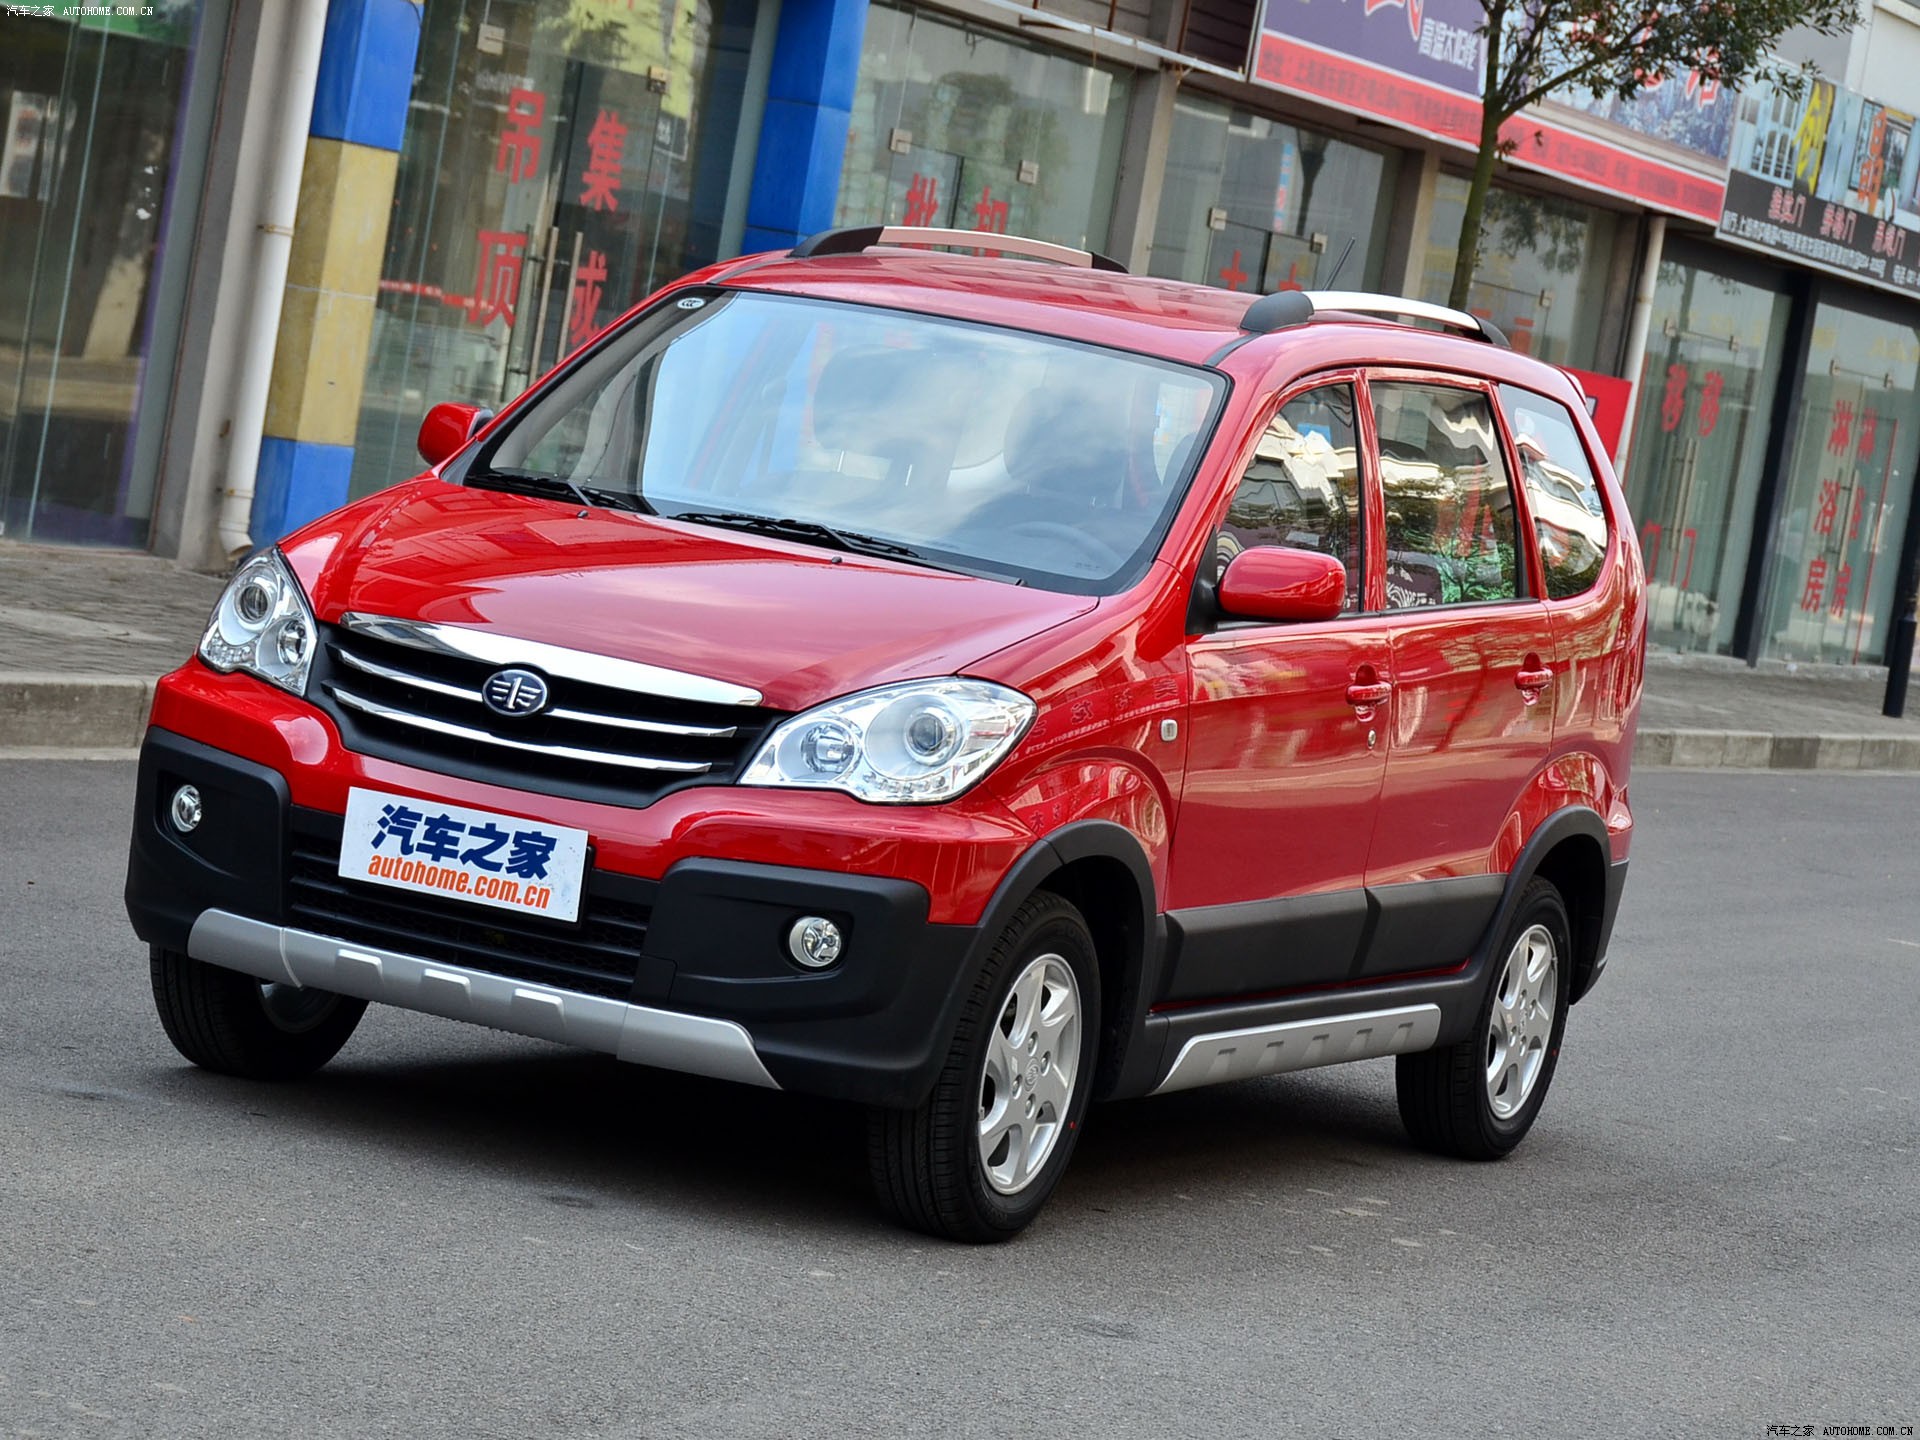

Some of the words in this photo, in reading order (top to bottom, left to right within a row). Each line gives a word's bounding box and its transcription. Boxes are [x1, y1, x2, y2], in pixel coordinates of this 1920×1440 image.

[467, 87, 546, 329] 吊顶
[570, 107, 629, 345] 集成
[367, 853, 552, 910] autohome.com.cn
[370, 802, 558, 881] 汽车之家
